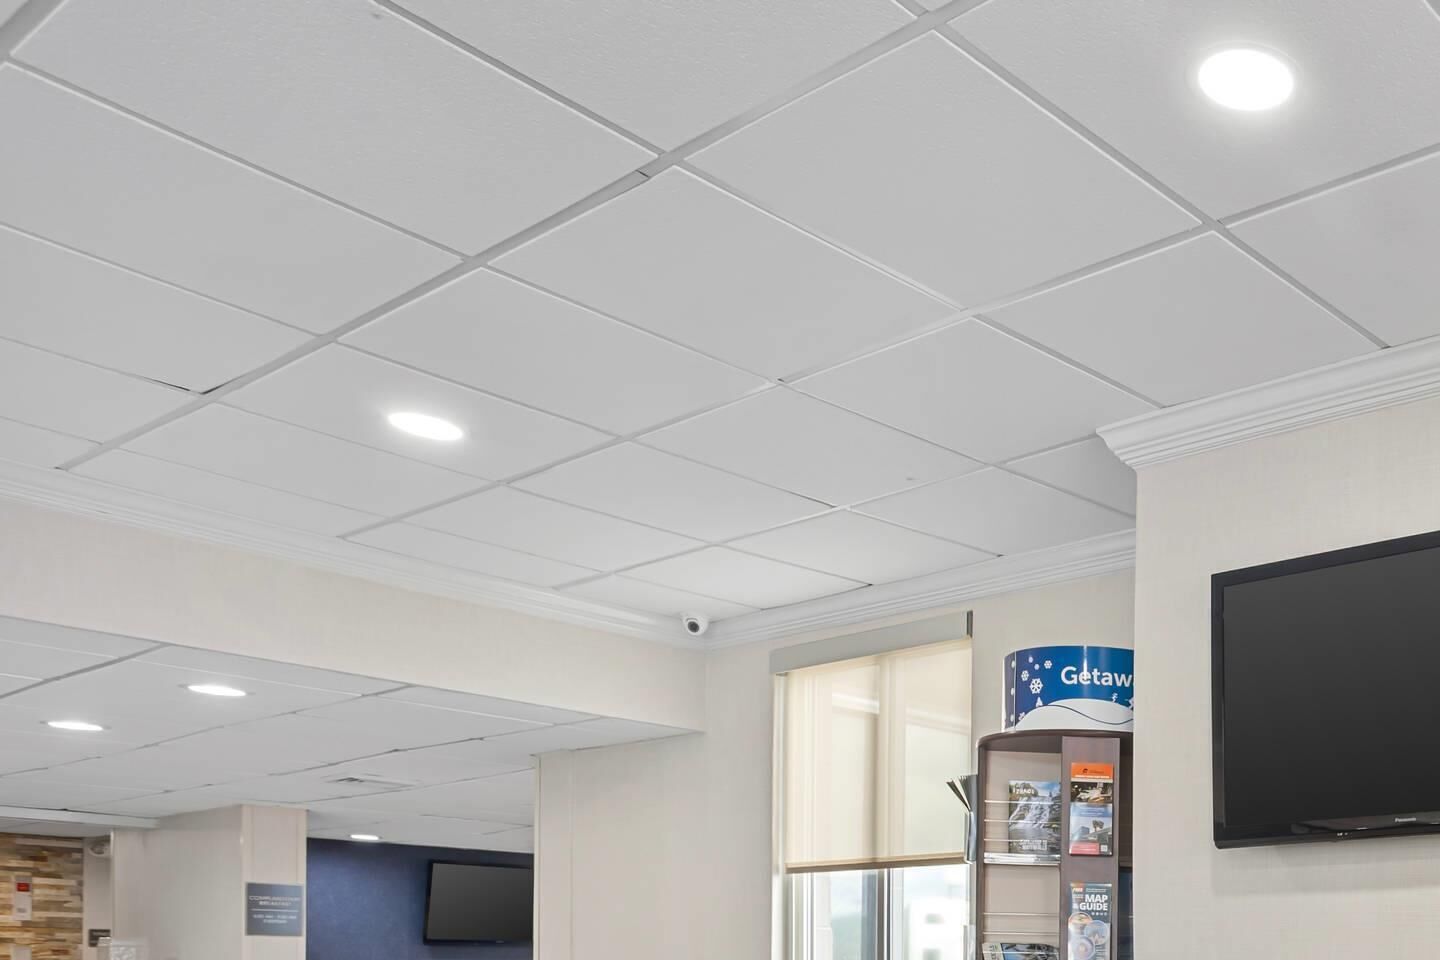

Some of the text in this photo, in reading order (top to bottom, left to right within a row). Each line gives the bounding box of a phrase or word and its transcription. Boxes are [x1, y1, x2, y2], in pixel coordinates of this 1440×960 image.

[1060, 665, 1134, 688] Getaw
[1084, 894, 1108, 903] MAP
[1079, 902, 1108, 911] GUIDE
